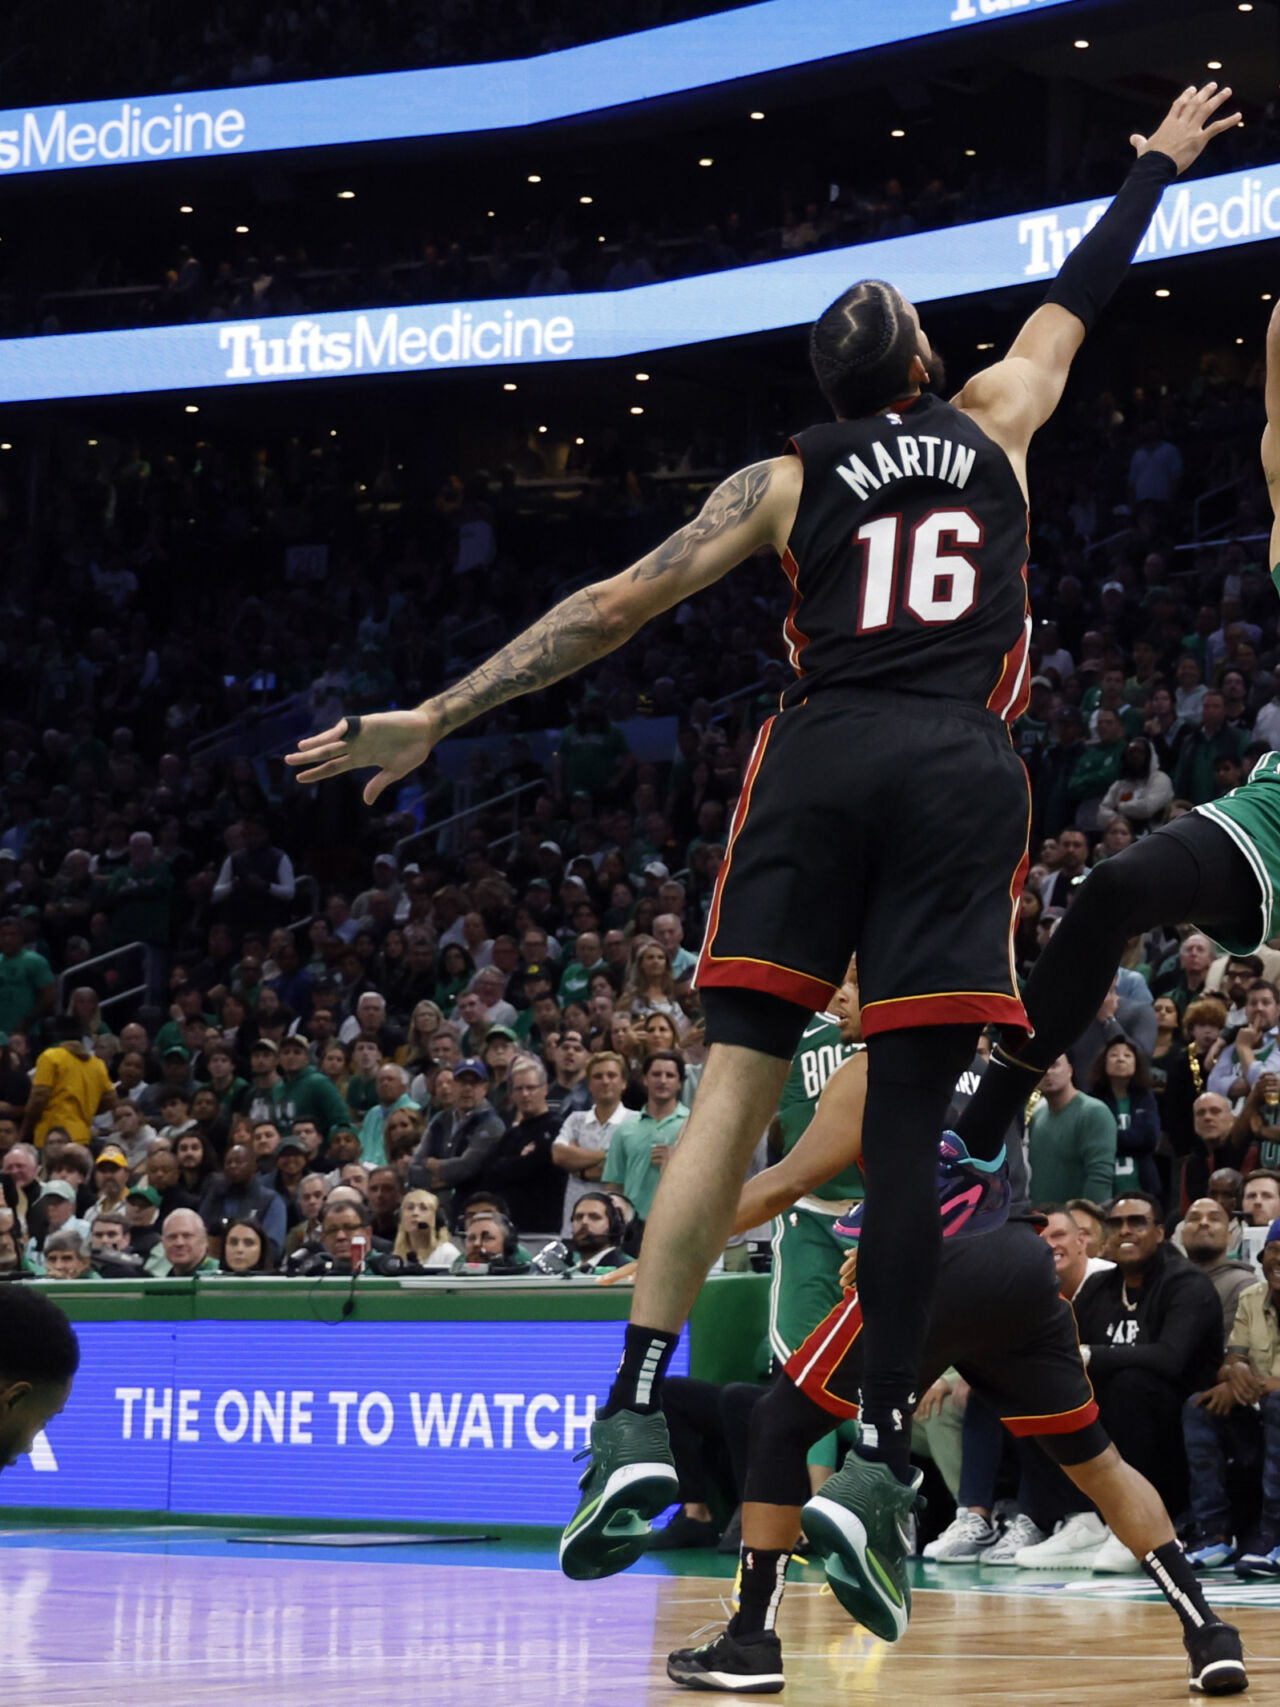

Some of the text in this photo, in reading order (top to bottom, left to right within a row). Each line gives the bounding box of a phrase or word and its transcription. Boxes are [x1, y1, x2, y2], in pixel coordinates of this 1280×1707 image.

[836, 436, 976, 501] MARTIN
[854, 507, 984, 636] 16
[115, 1387, 597, 1450] THE ONE TO WATCH
